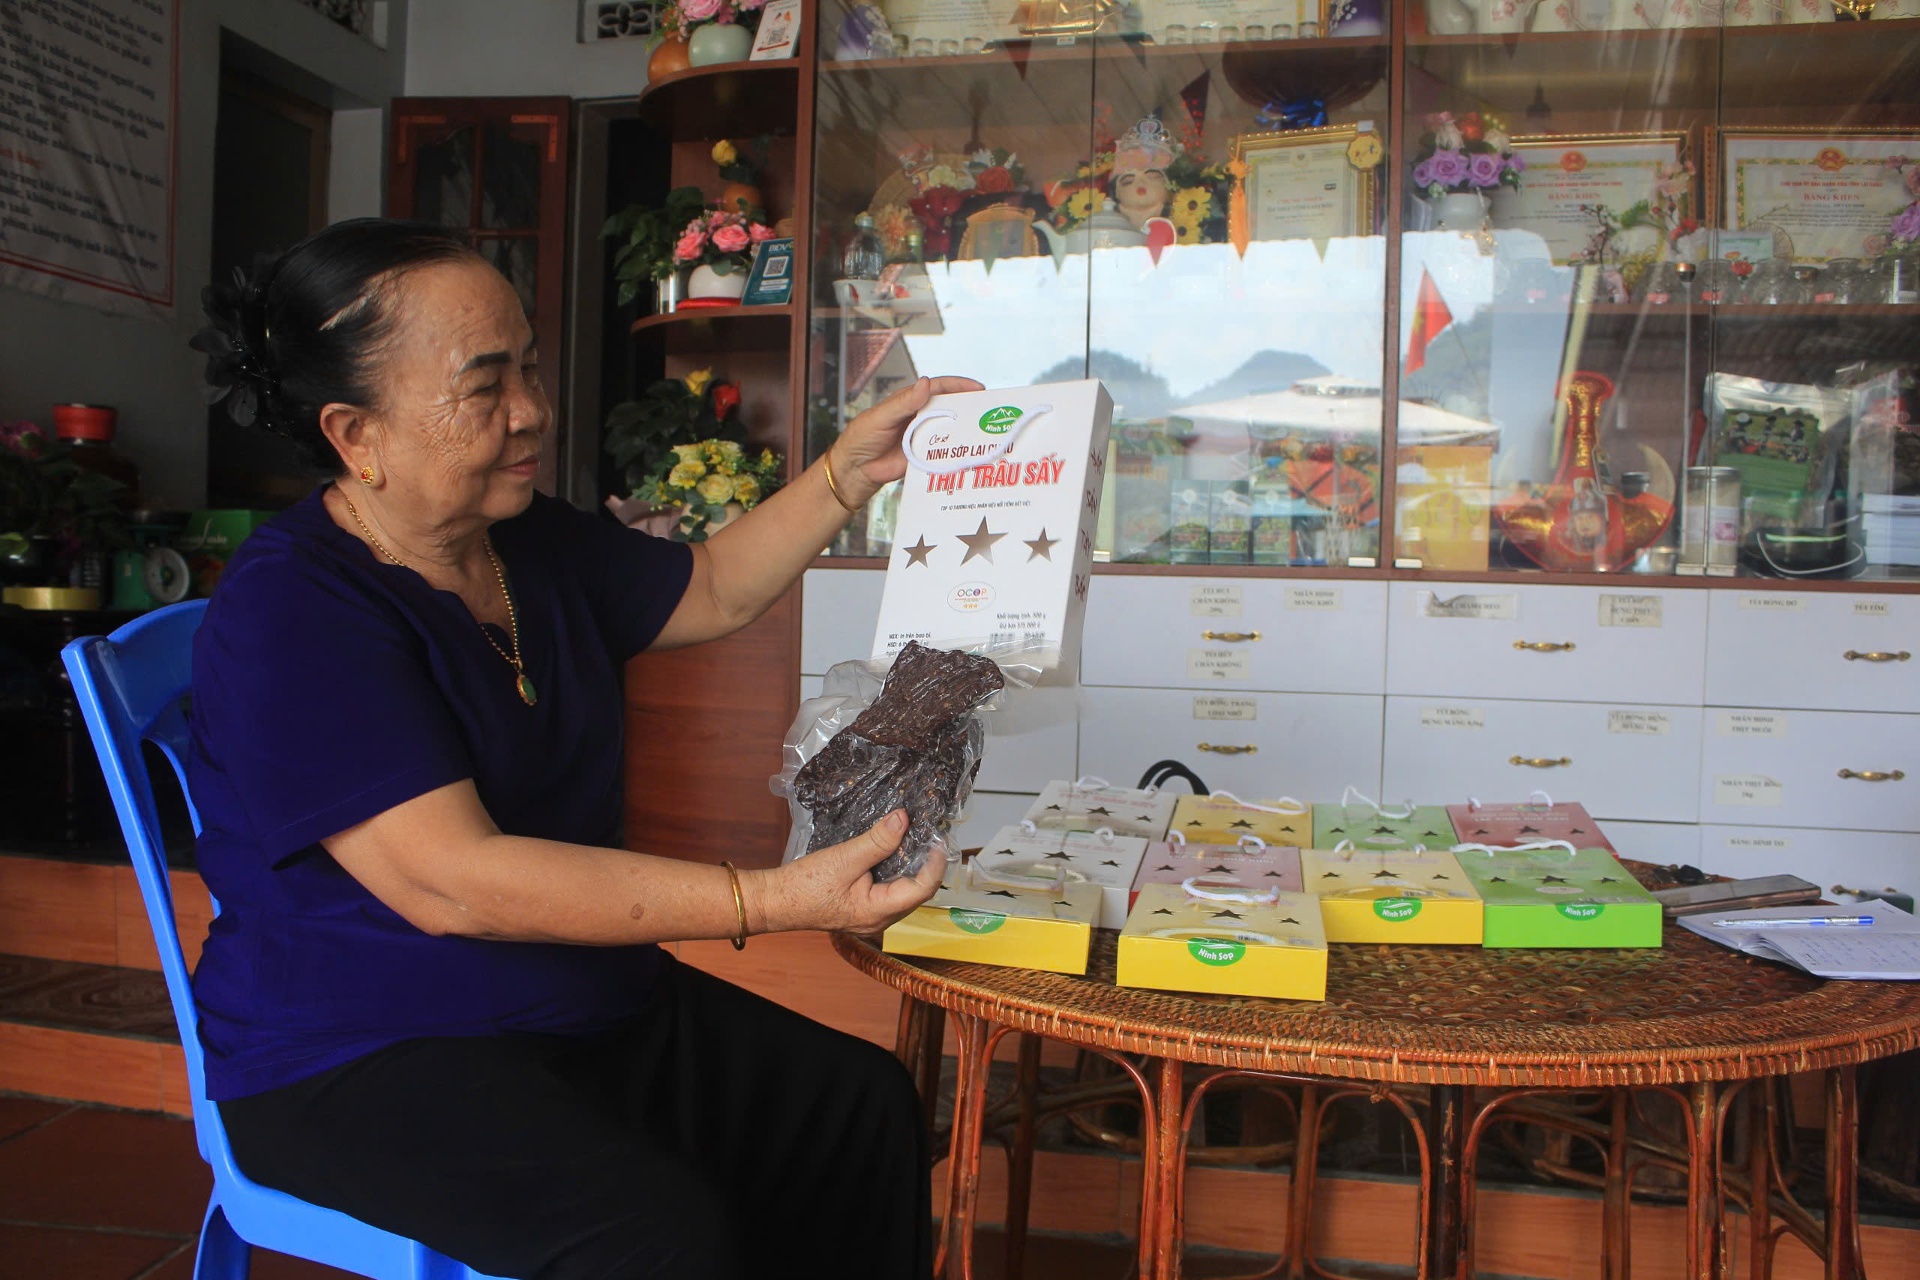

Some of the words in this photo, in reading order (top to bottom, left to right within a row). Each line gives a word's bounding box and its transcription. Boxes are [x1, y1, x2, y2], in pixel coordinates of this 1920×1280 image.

[985, 424, 1001, 432] Ninh
[926, 448, 949, 460] NINH
[950, 443, 969, 458] SỚP
[970, 444, 986, 457] LAI
[926, 467, 970, 496] THỊT
[971, 459, 1021, 489] TRÂU
[1023, 452, 1067, 486] SẤY
[957, 587, 987, 597] OCOP
[1382, 909, 1399, 917] Ninh
[1399, 908, 1413, 917] Sop
[1565, 906, 1581, 916] Ninh
[1582, 908, 1597, 917] Sop
[1198, 948, 1217, 960] Ninh
[1218, 952, 1235, 961] Sop
